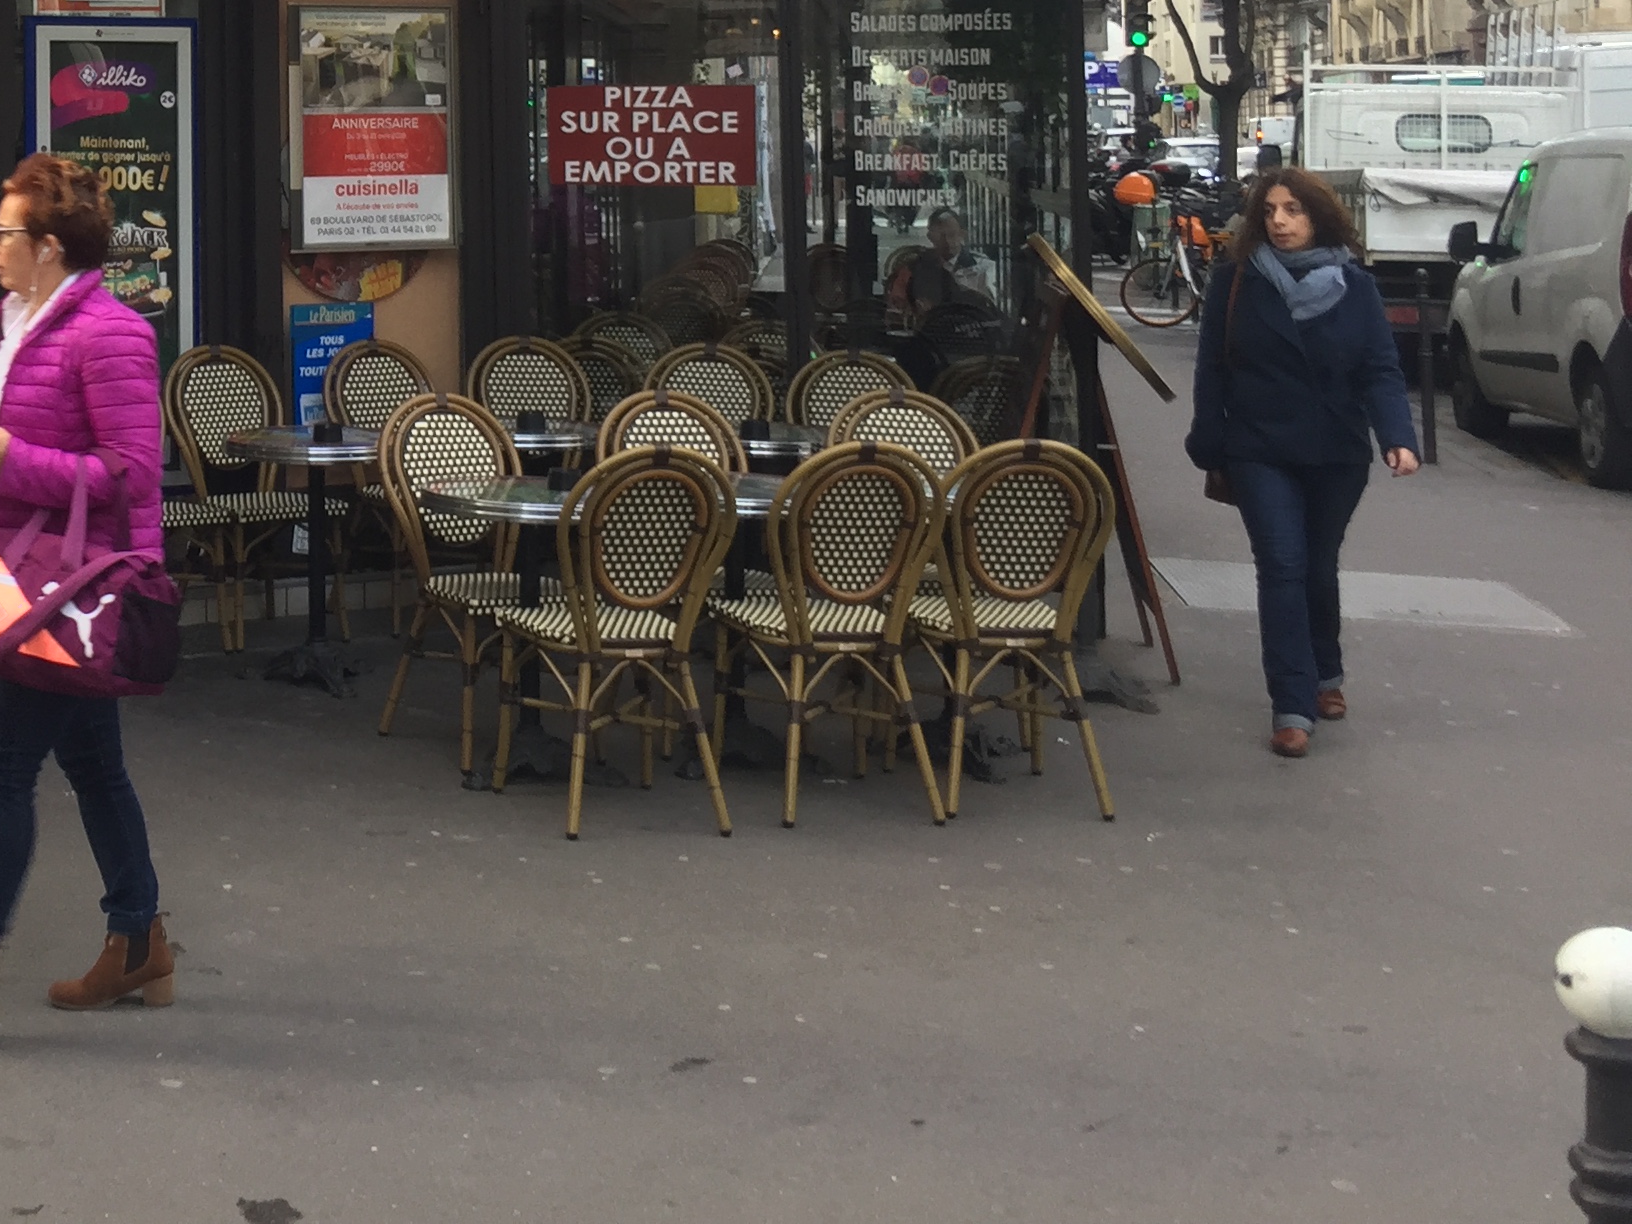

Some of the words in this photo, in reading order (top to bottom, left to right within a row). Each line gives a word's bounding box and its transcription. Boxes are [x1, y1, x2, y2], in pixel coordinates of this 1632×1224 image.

[850, 11, 916, 33] SALADES
[919, 7, 1012, 31] COMPOSÉES
[930, 47, 991, 67] MAISON
[96, 64, 147, 87] illiko
[604, 86, 694, 108] PIZZA
[948, 79, 1008, 102] SOUPES
[331, 117, 419, 130] ANNIVERSAIRE
[560, 110, 620, 134] SUR
[632, 110, 739, 134] PLACE
[79, 136, 150, 151] Maintenant,
[605, 136, 654, 160] OU
[666, 137, 691, 159] A
[87, 151, 100, 161] de
[102, 152, 135, 164] gagner
[137, 151, 171, 164] jusqu'à
[369, 161, 405, 172] 2990€
[854, 149, 939, 171] BREAKFAST
[949, 148, 1008, 171] CRÊPES
[564, 161, 736, 184] EMPORTER
[335, 179, 419, 197] cuisinella
[856, 184, 956, 207] SANDWICHES
[323, 216, 374, 225] BOULEVARD
[375, 215, 387, 224] DE
[317, 227, 343, 236] PARIS
[309, 309, 319, 324] Le
[319, 306, 356, 324] Parisien
[319, 335, 344, 346] TOUS
[306, 348, 324, 358] LES
